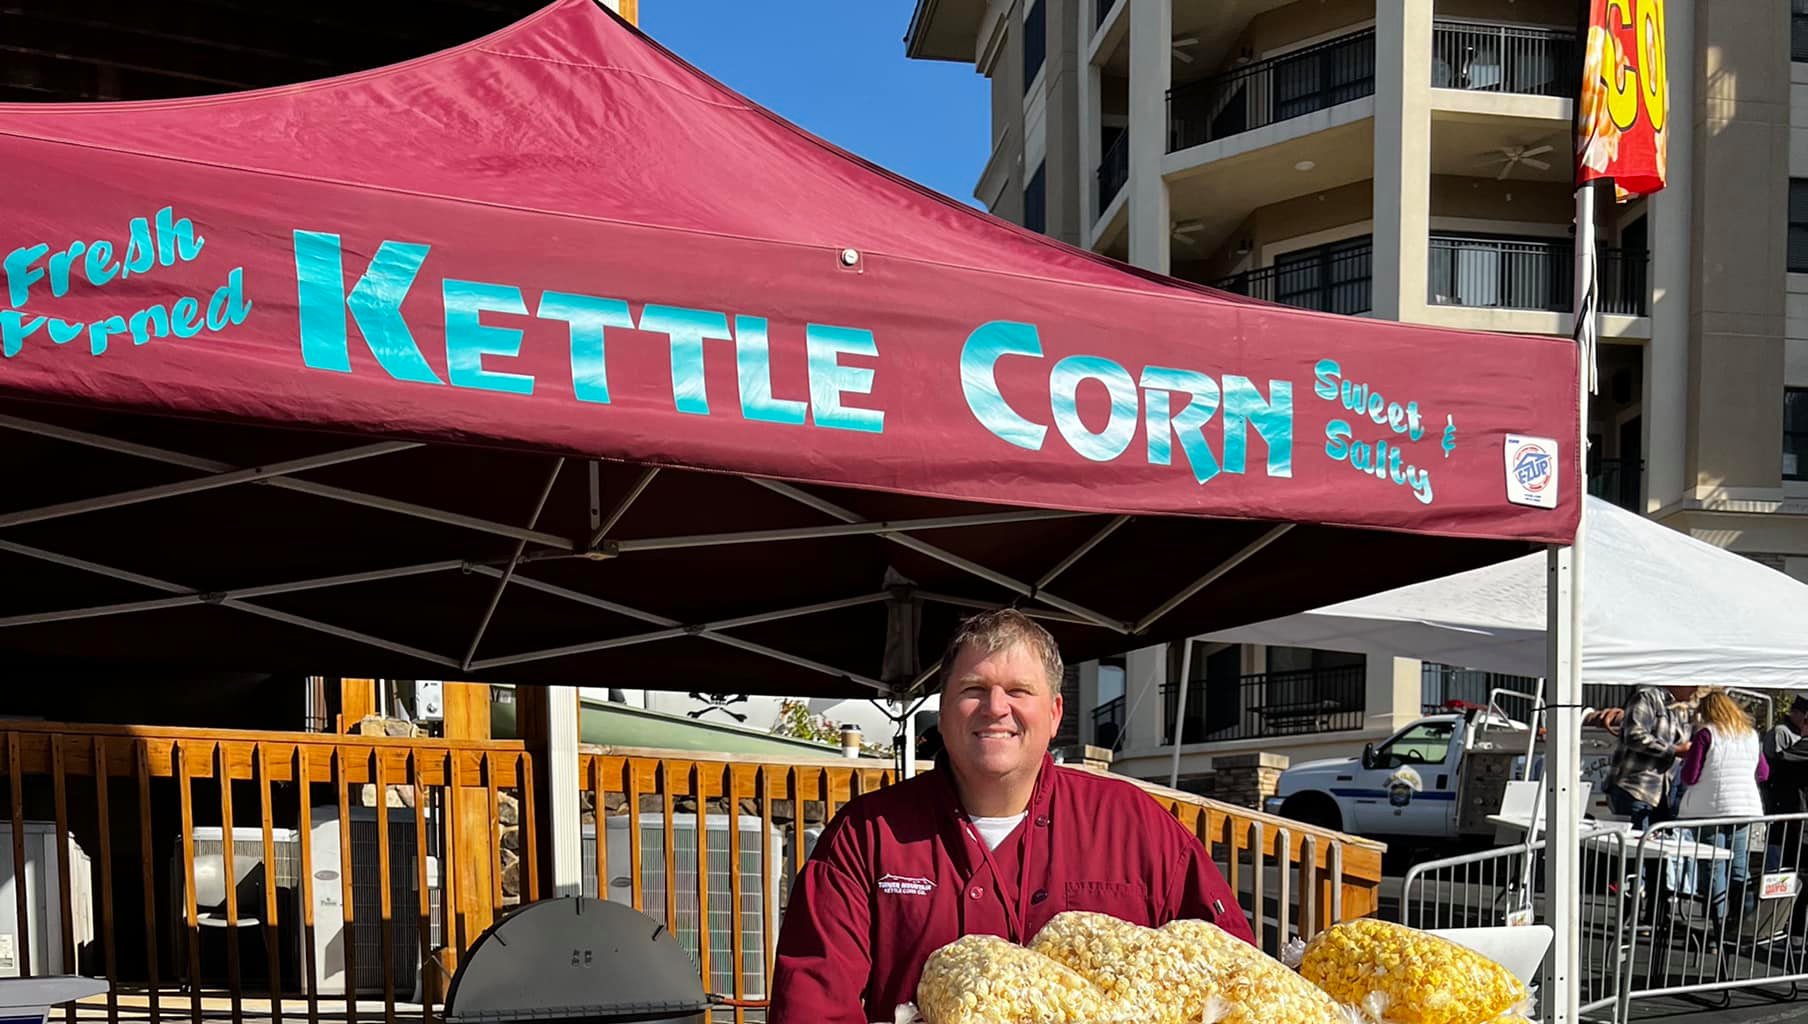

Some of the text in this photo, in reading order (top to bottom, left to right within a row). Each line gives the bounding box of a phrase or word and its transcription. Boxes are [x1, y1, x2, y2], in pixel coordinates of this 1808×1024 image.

[3, 206, 205, 308] Fresh
[293, 229, 1293, 485] KETTLE CORN
[1314, 358, 1456, 458] Sweet &
[1325, 419, 1433, 504] Salty
